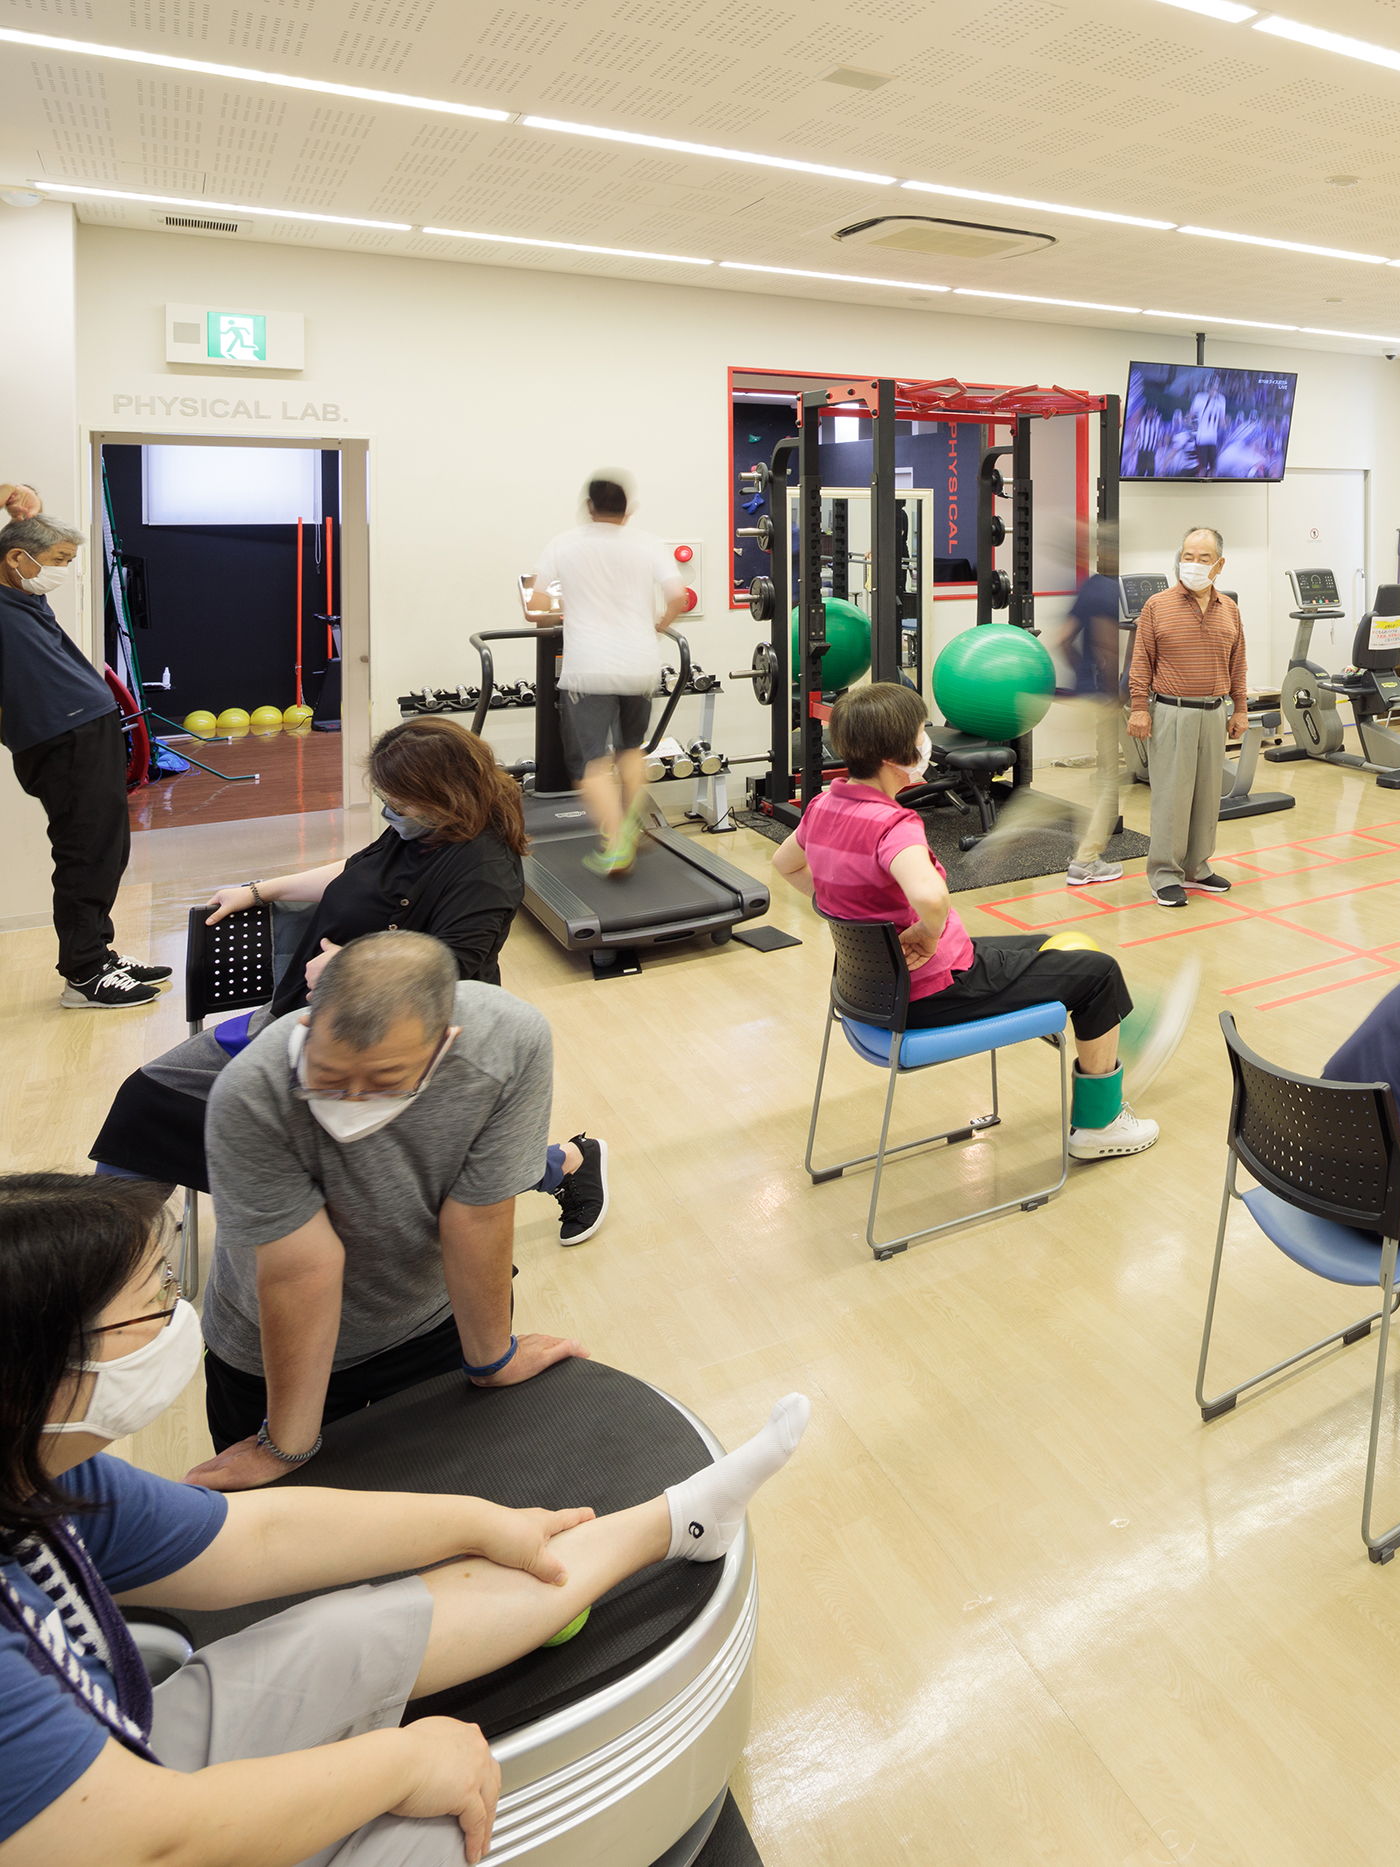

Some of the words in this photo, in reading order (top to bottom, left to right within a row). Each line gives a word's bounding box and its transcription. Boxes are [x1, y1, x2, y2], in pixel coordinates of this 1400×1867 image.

[113, 394, 271, 420] PHYSICAL
[282, 401, 348, 423] LAB.
[948, 422, 958, 554] PHYSICAL
